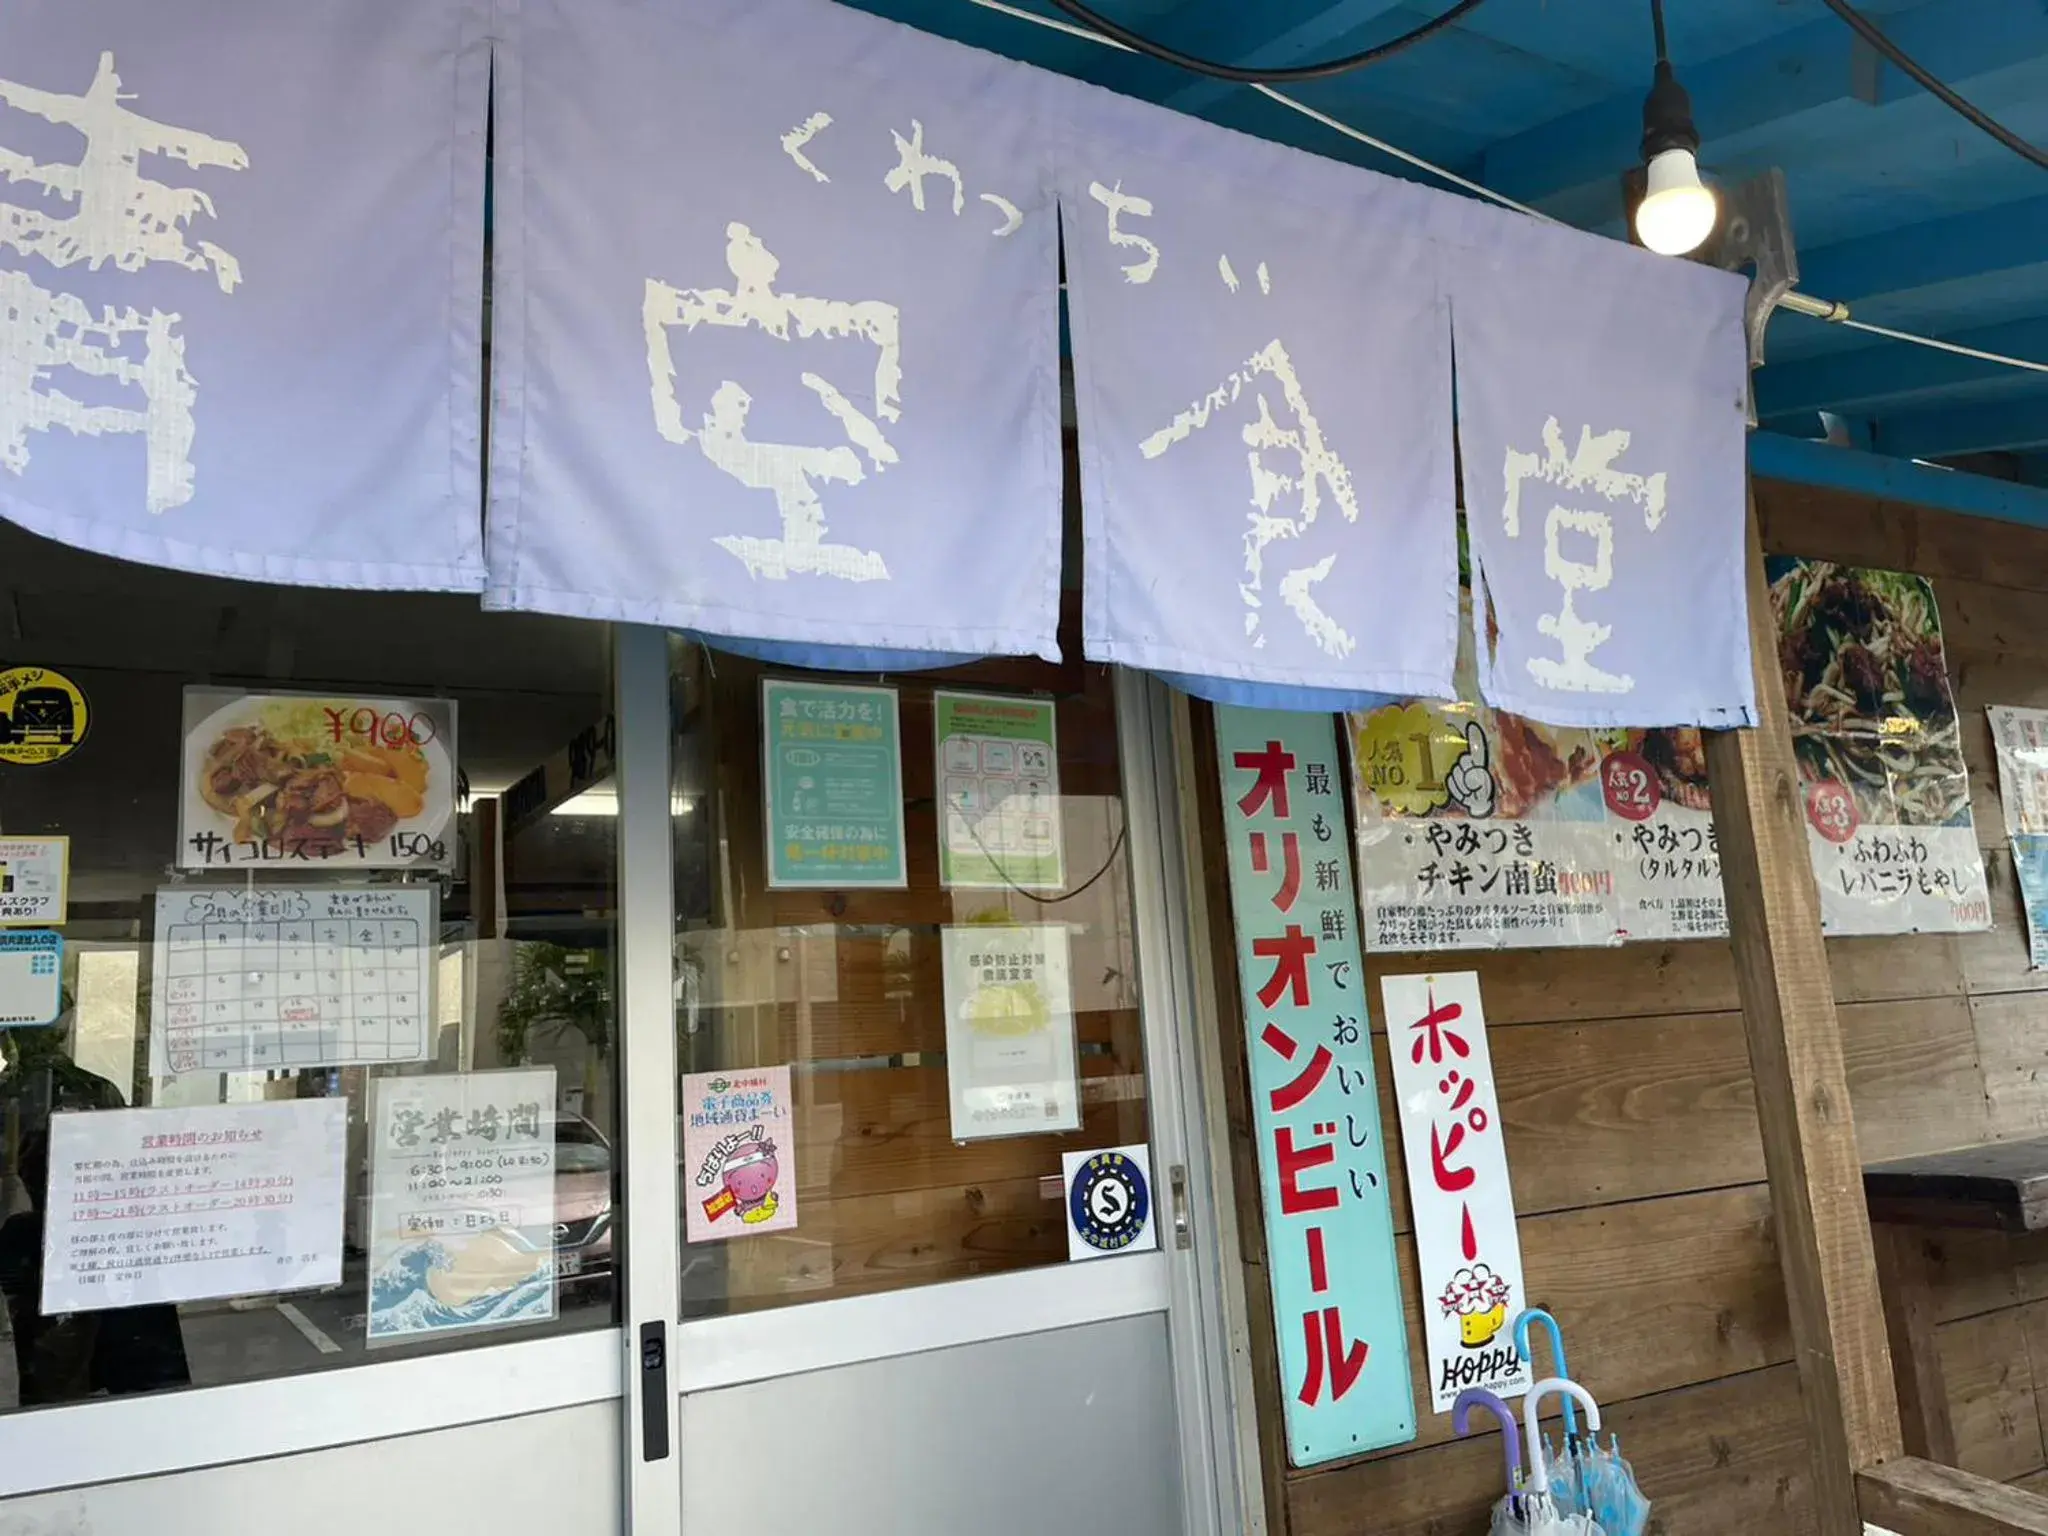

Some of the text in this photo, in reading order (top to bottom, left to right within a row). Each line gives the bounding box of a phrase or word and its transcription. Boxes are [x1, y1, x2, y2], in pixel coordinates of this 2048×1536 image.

[323, 707, 436, 746] ¥900
[1629, 769, 1650, 804] 2
[1831, 796, 1849, 827] 3
[390, 831, 448, 861] 150g
[1839, 867, 1968, 896] レバニラもやし
[1305, 763, 1377, 1199] 最も新鮮でおいしい
[1232, 740, 1369, 1407] オリオンビール
[140, 1128, 263, 1148] 営業時間のお知らせ
[1409, 984, 1487, 1261] ホッピー
[1099, 1184, 1122, 1217] S
[1440, 1346, 1522, 1391] Hoppy
